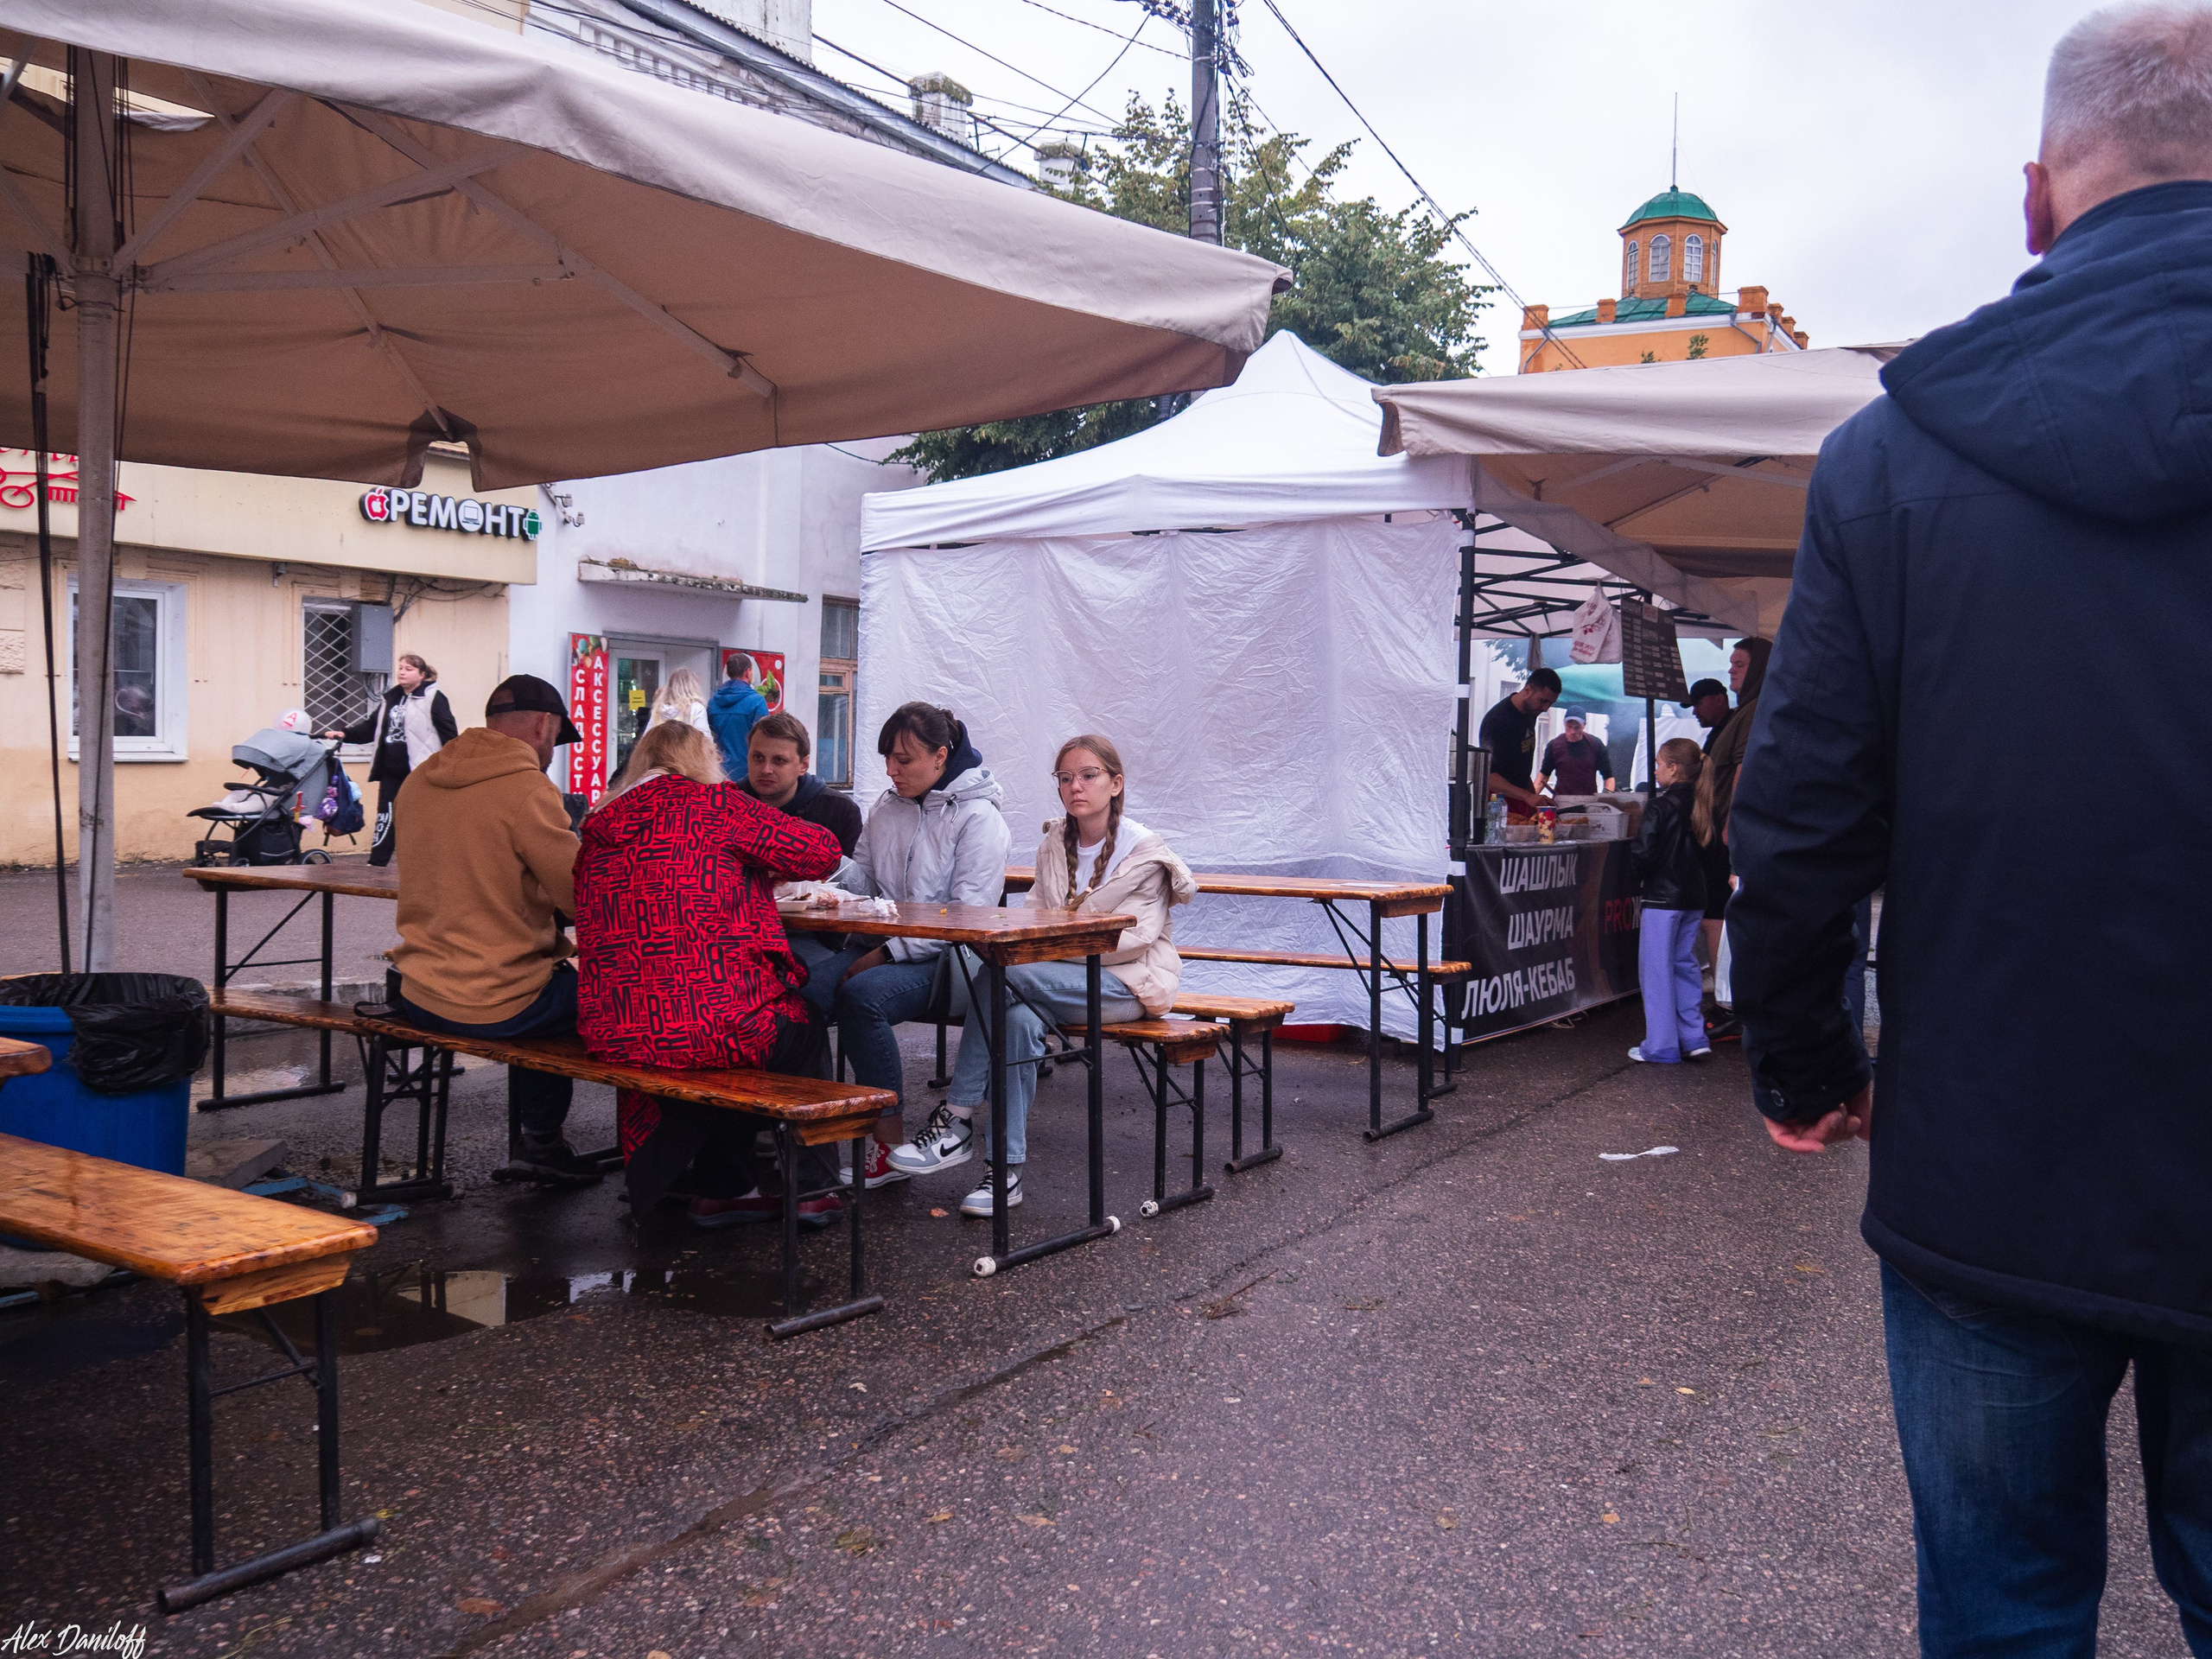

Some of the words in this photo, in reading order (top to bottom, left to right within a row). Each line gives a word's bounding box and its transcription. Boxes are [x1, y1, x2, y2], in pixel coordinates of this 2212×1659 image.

[390, 487, 525, 537] РЕМОНТ
[573, 669, 586, 794] СЛАДОСТ
[590, 655, 604, 810] АКСЕССУАР
[1499, 854, 1579, 894] ШАШЛЫК
[1507, 905, 1574, 950] ШАУРМА
[1461, 957, 1576, 1020] ЛЮЛЯ-КЕБАБ
